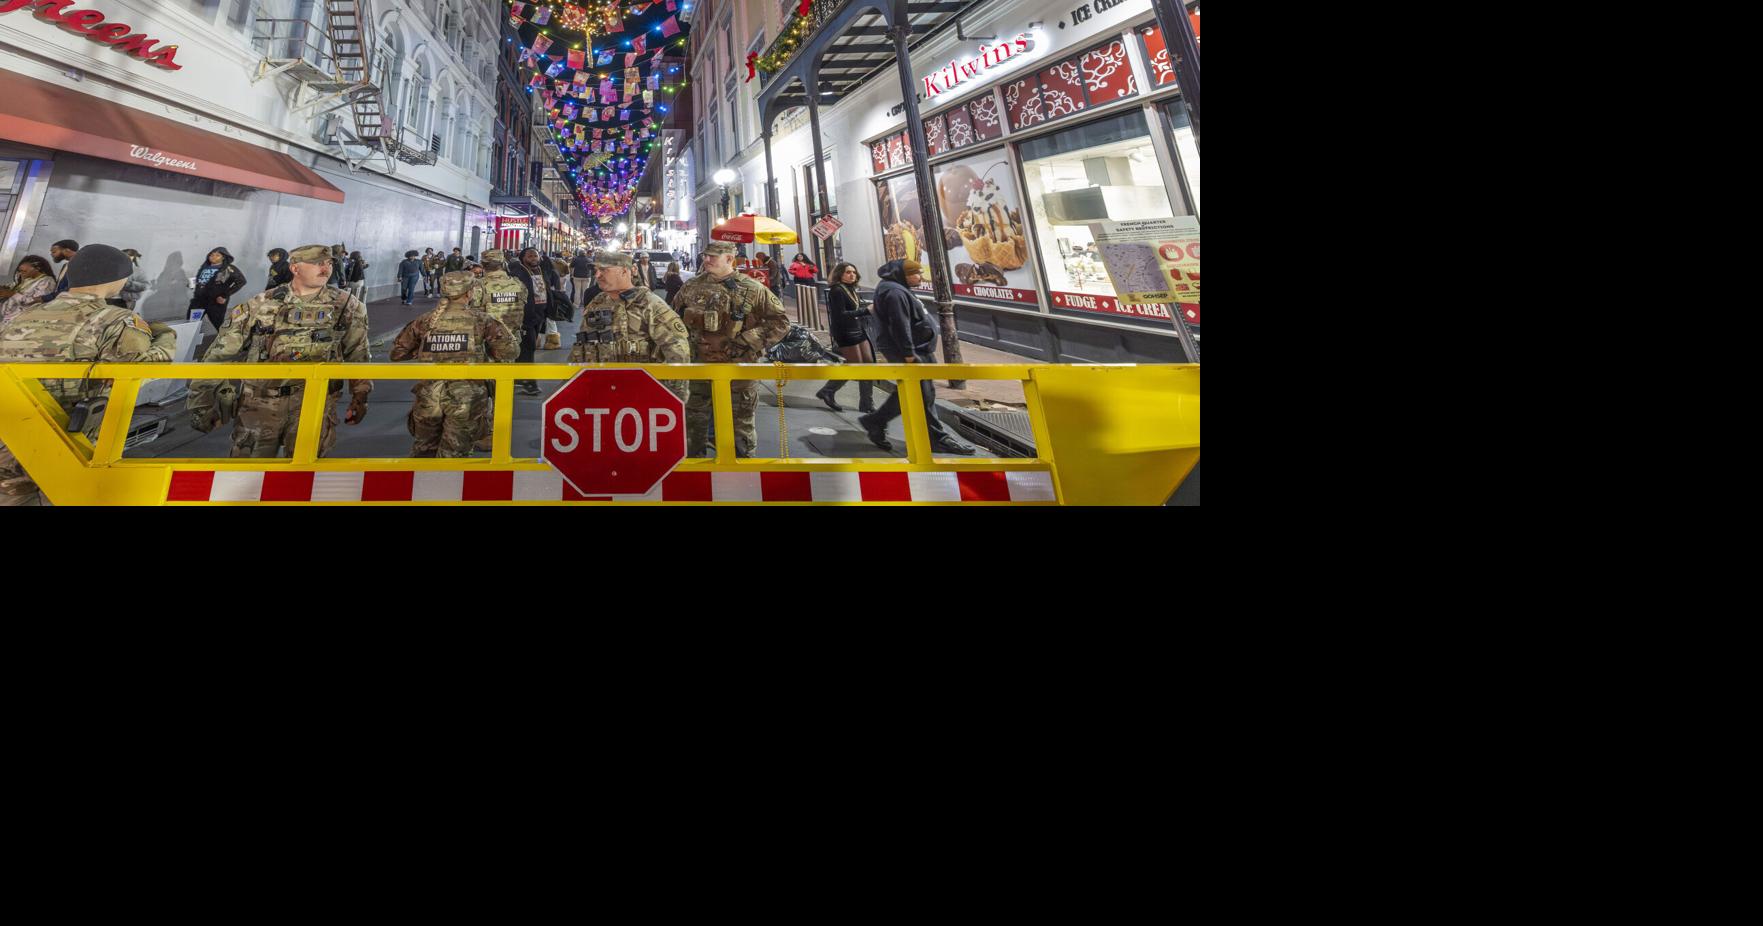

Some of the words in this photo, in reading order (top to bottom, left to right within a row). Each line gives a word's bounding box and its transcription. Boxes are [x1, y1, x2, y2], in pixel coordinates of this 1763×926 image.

[1071, 4, 1092, 26] ICE
[1093, 0, 1127, 14] CRE
[922, 32, 1028, 99] Kilwins
[129, 144, 197, 170] Walgreens
[664, 136, 675, 208] Krystal
[973, 286, 1014, 300] CHOCOLATES
[1064, 294, 1098, 309] FUDGE
[1136, 304, 1170, 317] CREA
[427, 333, 467, 343] NATIONAL
[431, 343, 461, 351] GUARD
[551, 407, 677, 453] STOP
